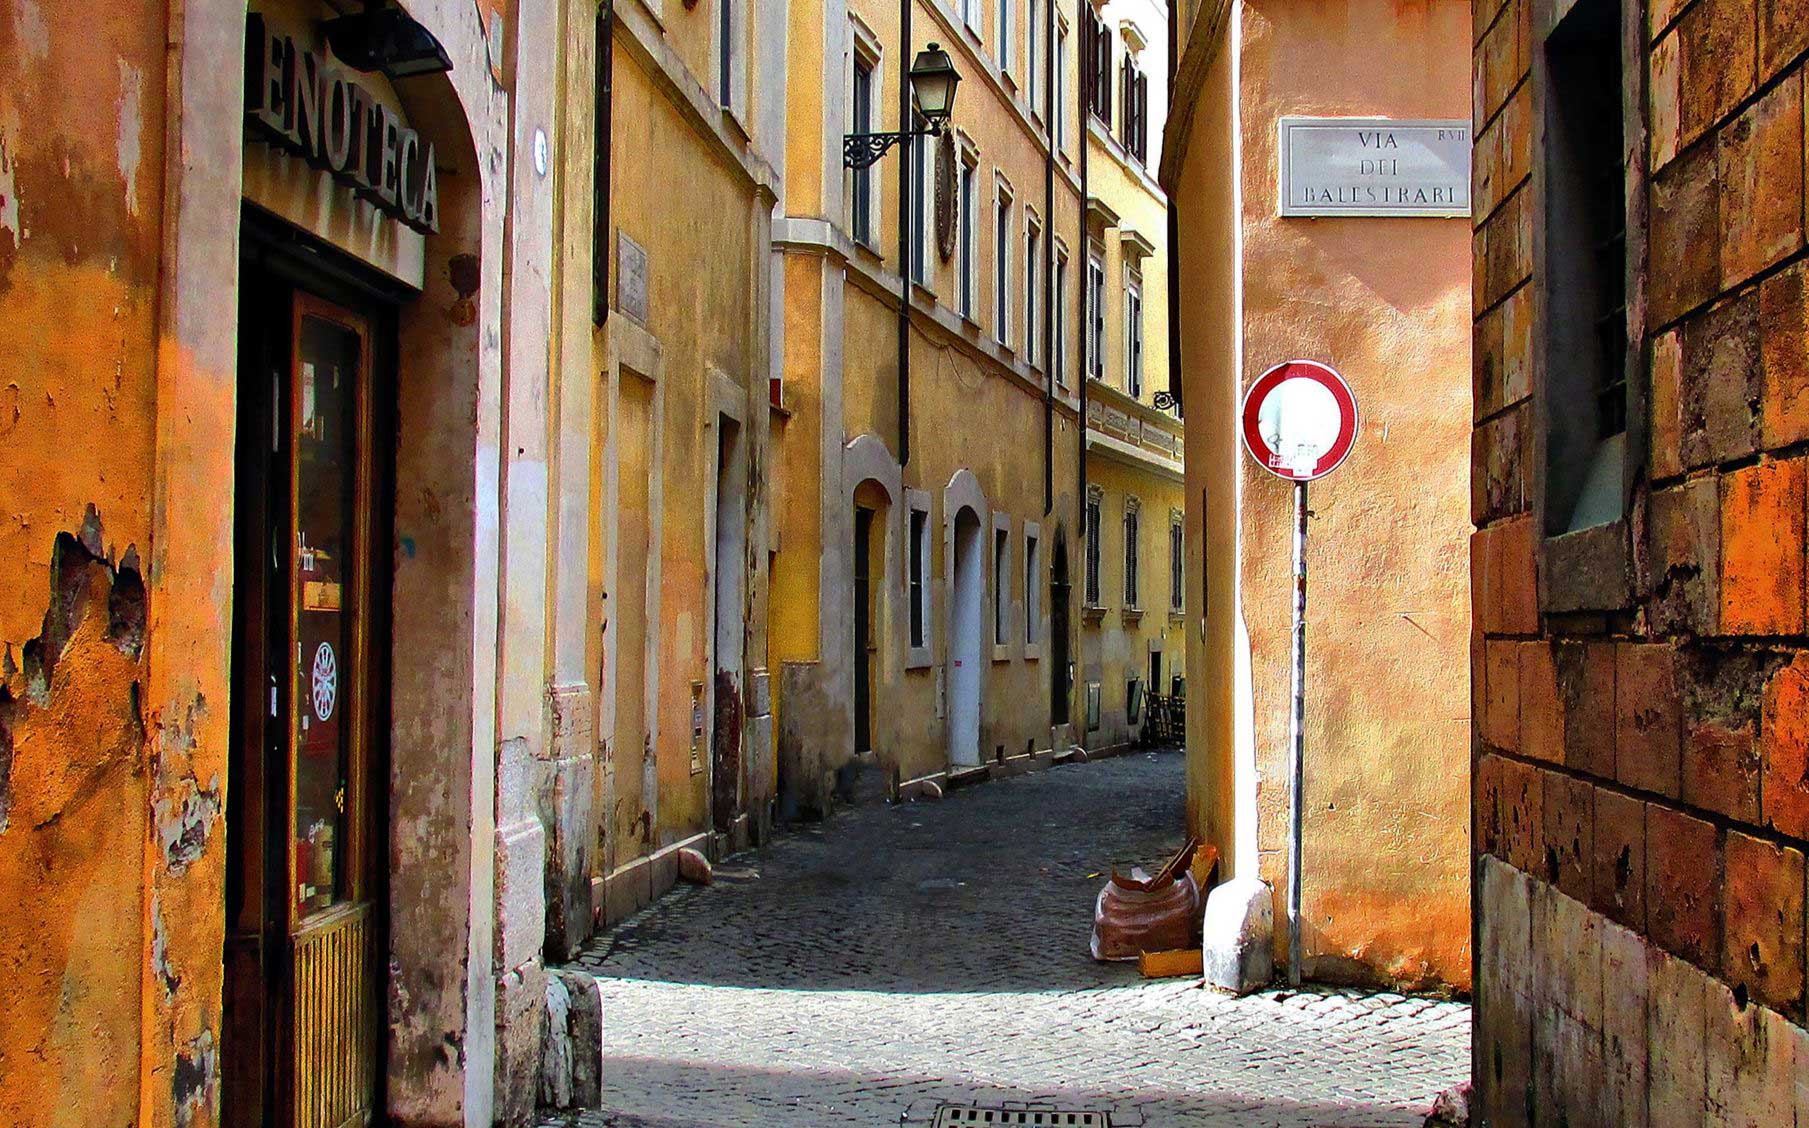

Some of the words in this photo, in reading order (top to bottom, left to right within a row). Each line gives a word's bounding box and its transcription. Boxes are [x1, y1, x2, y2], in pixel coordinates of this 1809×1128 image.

[248, 15, 439, 234] ENOTECA
[1359, 132, 1397, 148] VIA
[1361, 159, 1397, 175] DEI
[1305, 187, 1454, 203] BALESTRARI
